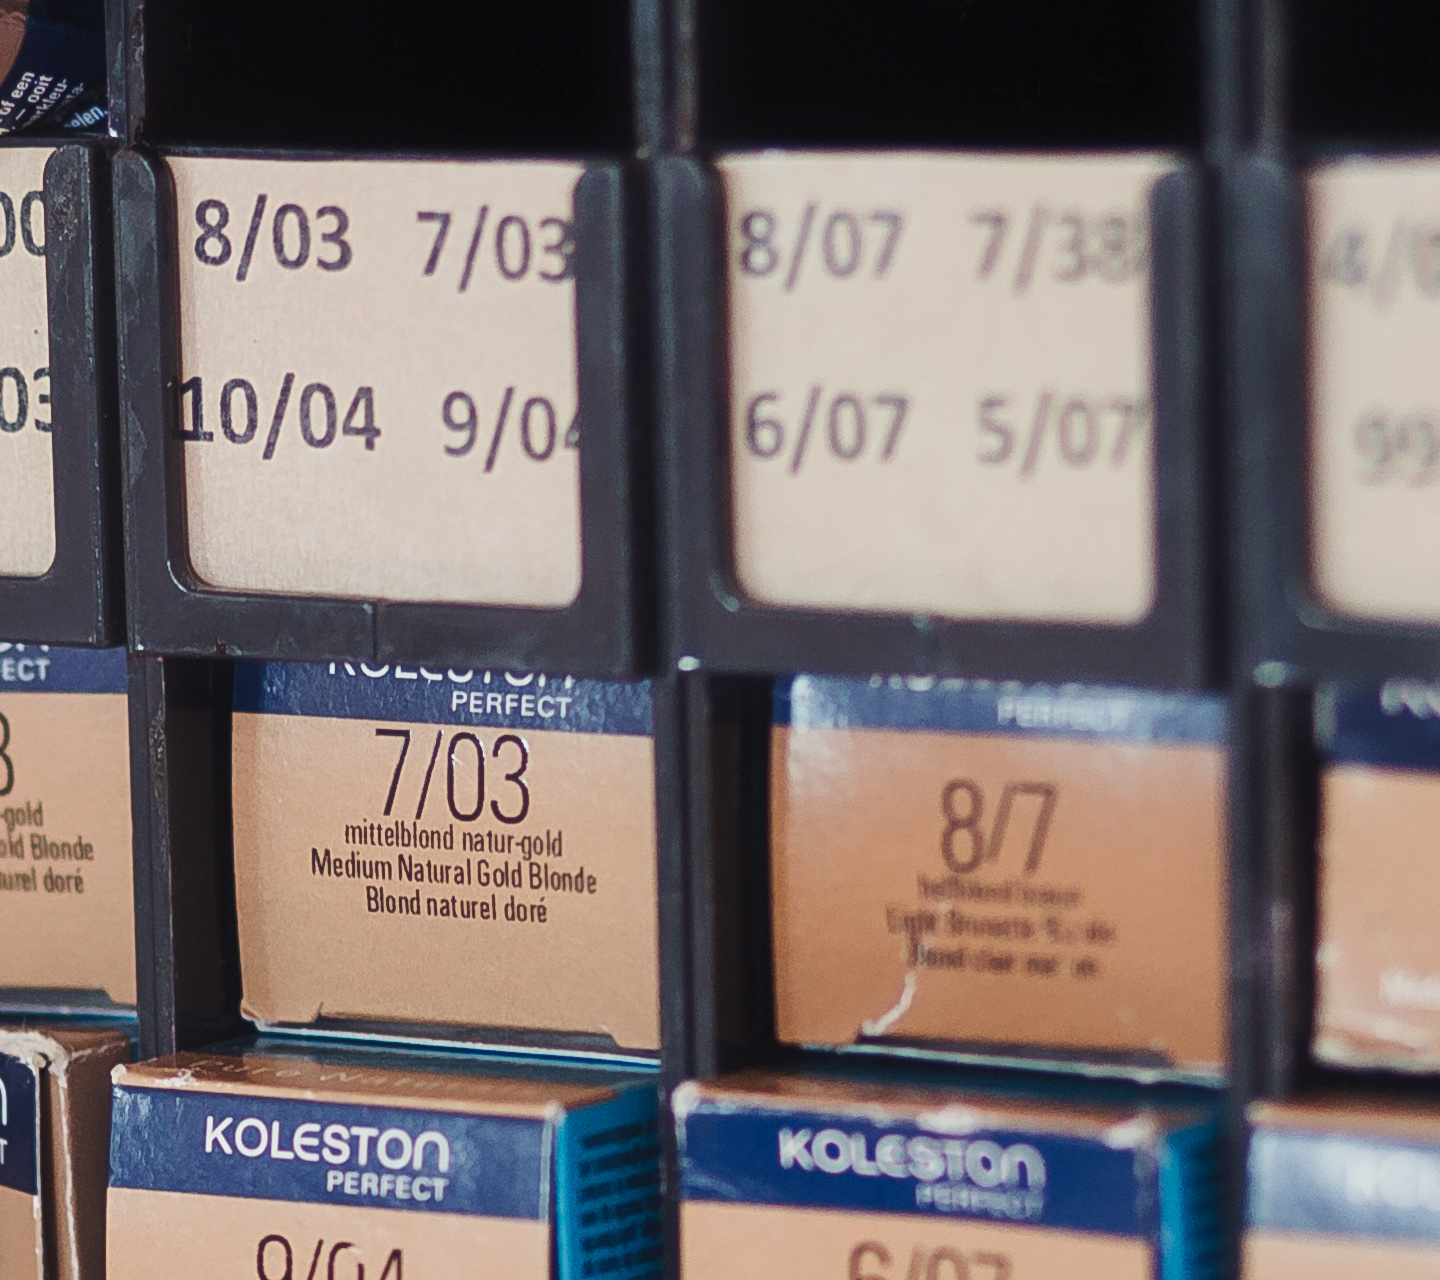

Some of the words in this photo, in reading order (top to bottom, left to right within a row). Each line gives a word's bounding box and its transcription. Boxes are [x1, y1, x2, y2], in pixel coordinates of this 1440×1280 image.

[11, 71, 36, 100] een
[194, 193, 354, 282] 8/03
[416, 204, 575, 293] 7/03
[739, 204, 905, 293] 8/07
[170, 372, 382, 460] 10/04
[745, 384, 912, 475] 6/07
[975, 390, 1148, 480] 5/07
[451, 691, 573, 719] PERFECT
[374, 728, 531, 825] 7/03
[29, 832, 95, 862] Blonde
[344, 818, 454, 852] mittelblond
[462, 828, 564, 860] natur-gold
[938, 776, 1060, 875] 8/7
[43, 866, 84, 894] doré
[310, 847, 392, 882] Medium
[397, 854, 472, 887] Natural
[476, 859, 522, 890] Gold
[528, 862, 598, 895] Blonde
[366, 886, 421, 917] Blond
[427, 892, 496, 921] naturel
[504, 896, 548, 924] doré
[204, 1115, 451, 1174] KOLESTON
[777, 1125, 1048, 1193] KOLESTON
[326, 1170, 451, 1203] PERFECT
